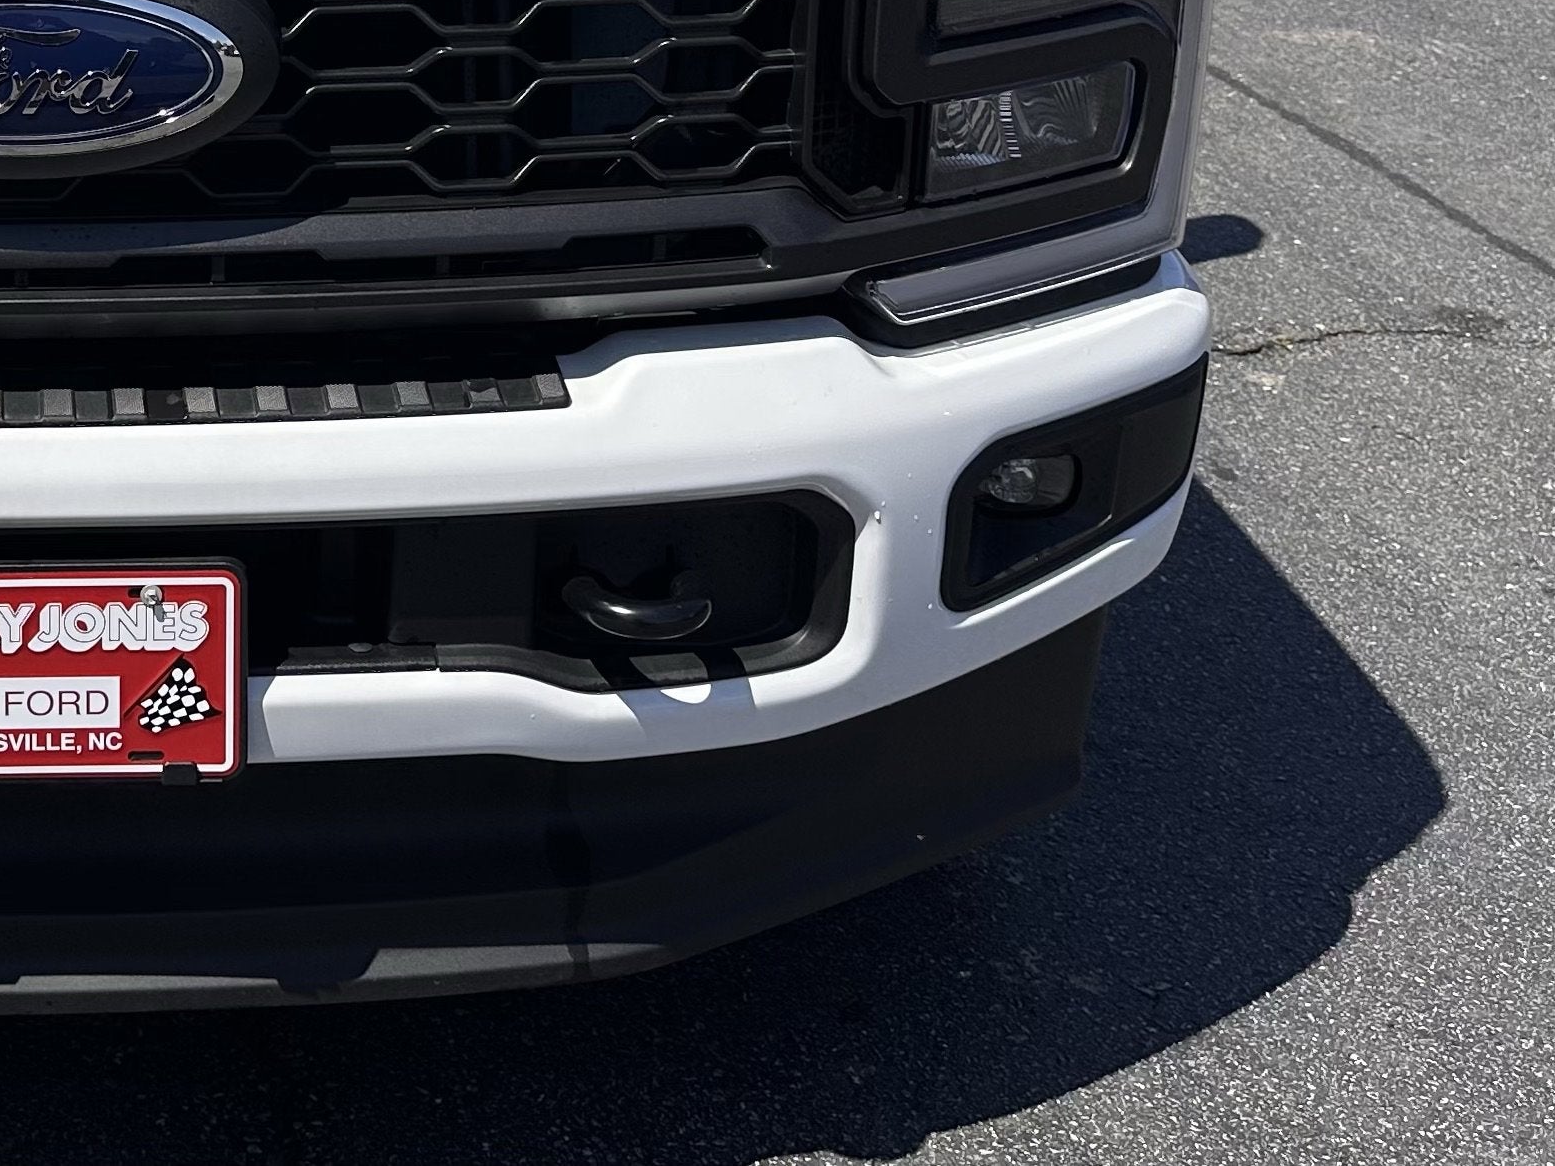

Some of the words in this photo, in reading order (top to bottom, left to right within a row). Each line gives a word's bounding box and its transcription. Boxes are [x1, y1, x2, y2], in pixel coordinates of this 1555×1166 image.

[28, 600, 210, 653] JONES
[4, 690, 110, 716] FORD
[88, 732, 123, 751] NC
